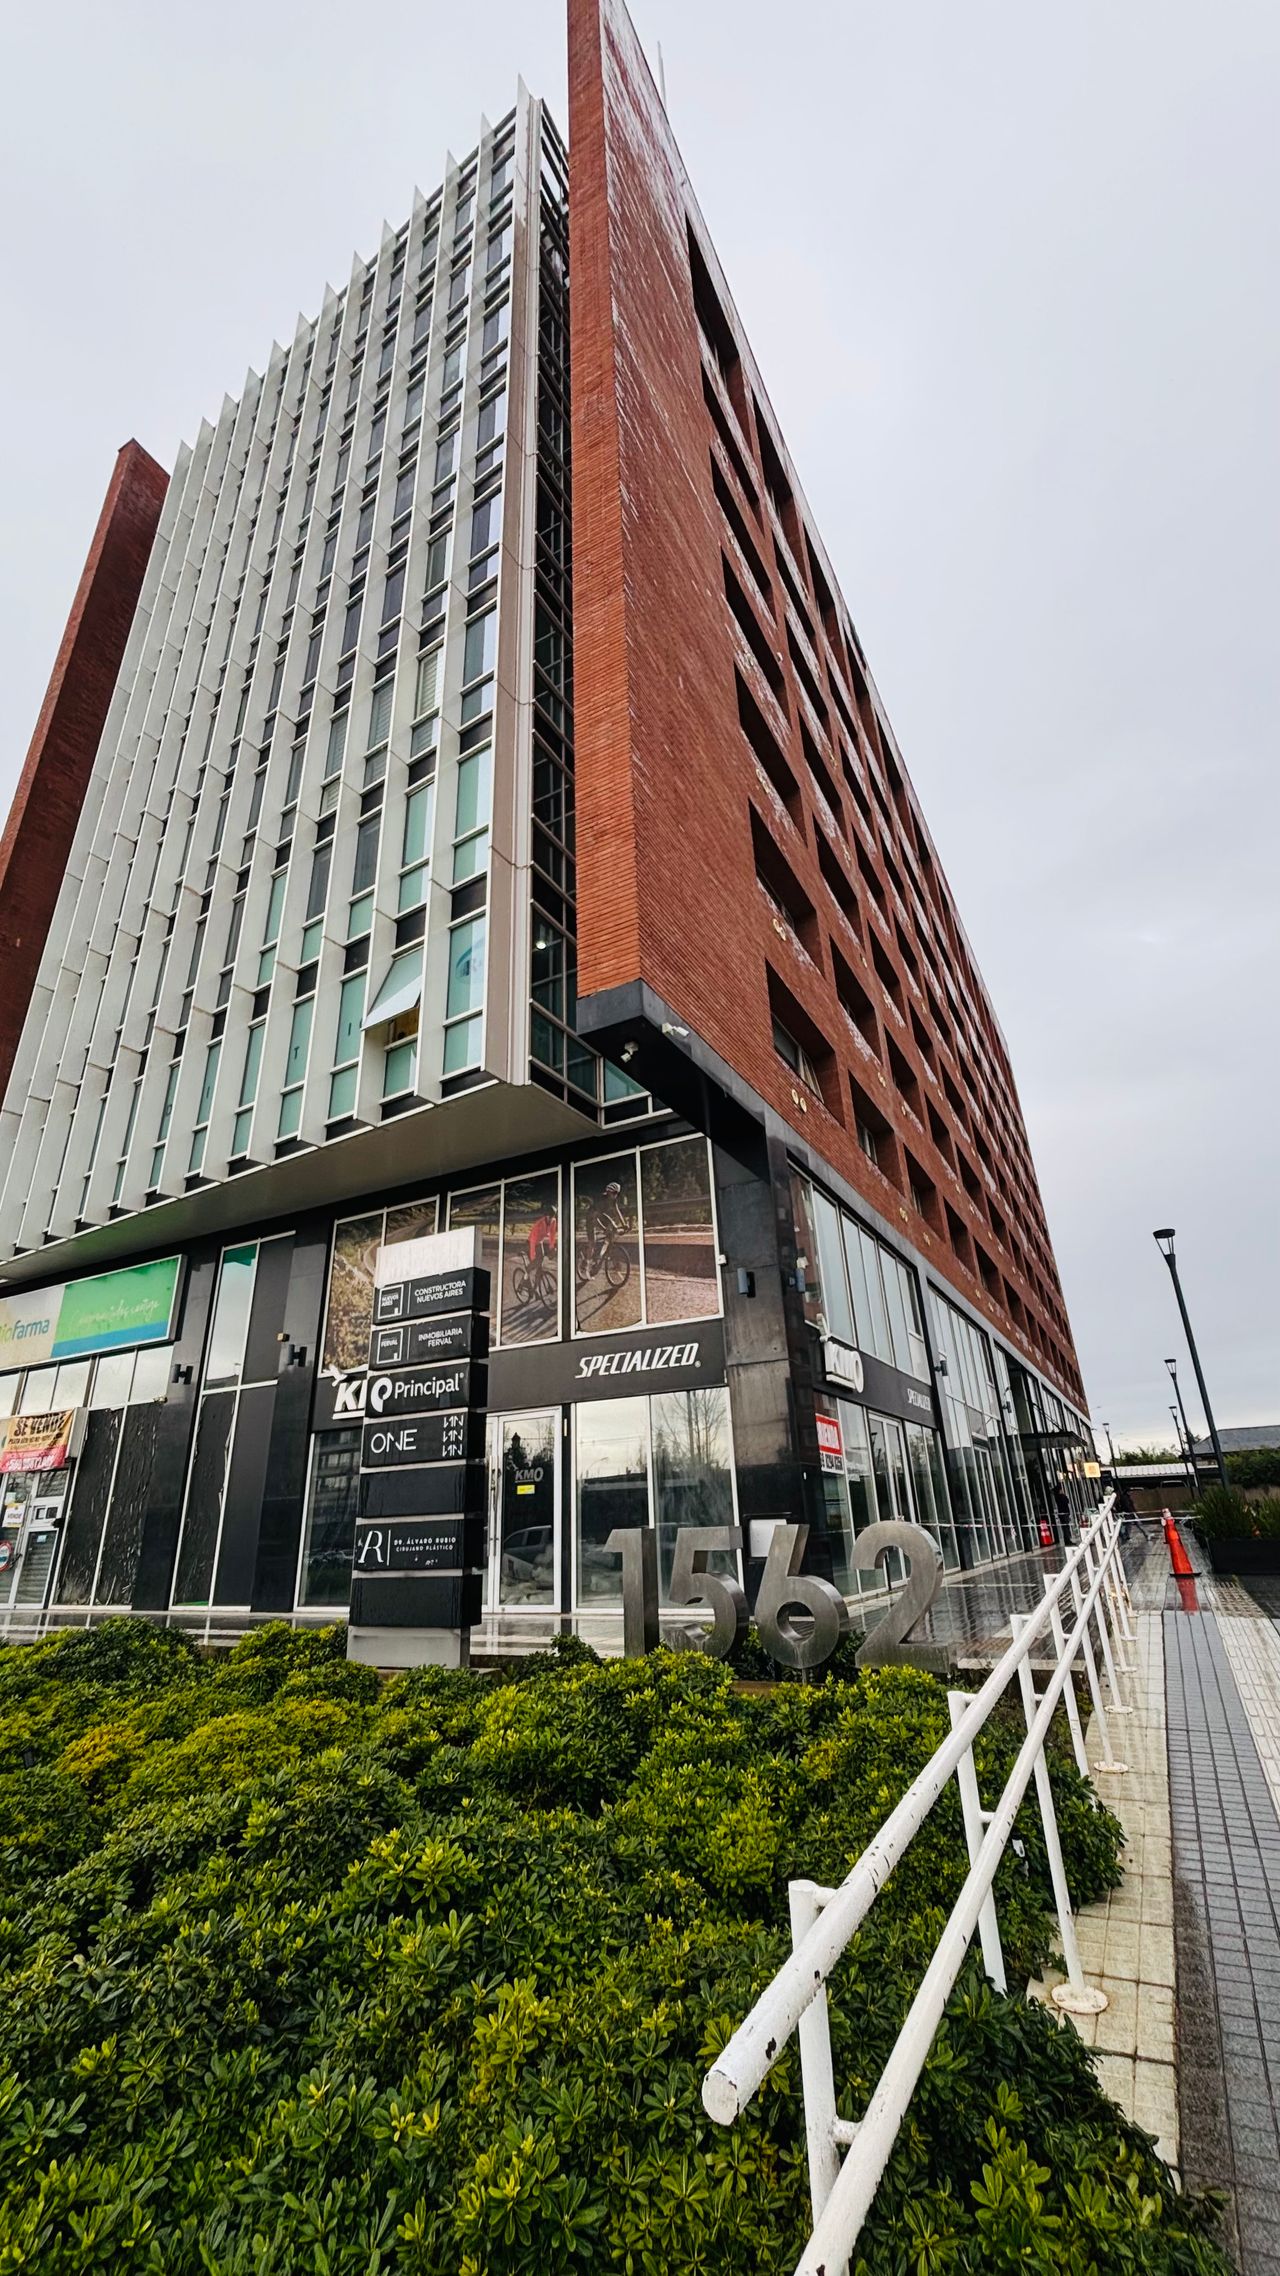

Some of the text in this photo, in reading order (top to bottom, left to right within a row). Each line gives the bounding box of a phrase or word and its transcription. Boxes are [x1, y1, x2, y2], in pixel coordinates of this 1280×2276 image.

[414, 1280, 466, 1297] CONSTRUCTORA
[416, 1288, 463, 1304] NUEVOS AIRES
[0, 1319, 50, 1346] iofarma
[418, 1327, 463, 1341] INMOBILIARIA
[427, 1337, 452, 1348] FERVAL
[575, 1342, 699, 1379] SPECIALIZED
[395, 1373, 460, 1399] Principal
[14, 1418, 28, 1436] SE
[370, 1429, 417, 1453] ONE
[406, 1537, 433, 1545] ÁLVARO
[602, 1520, 957, 1674] 1562
